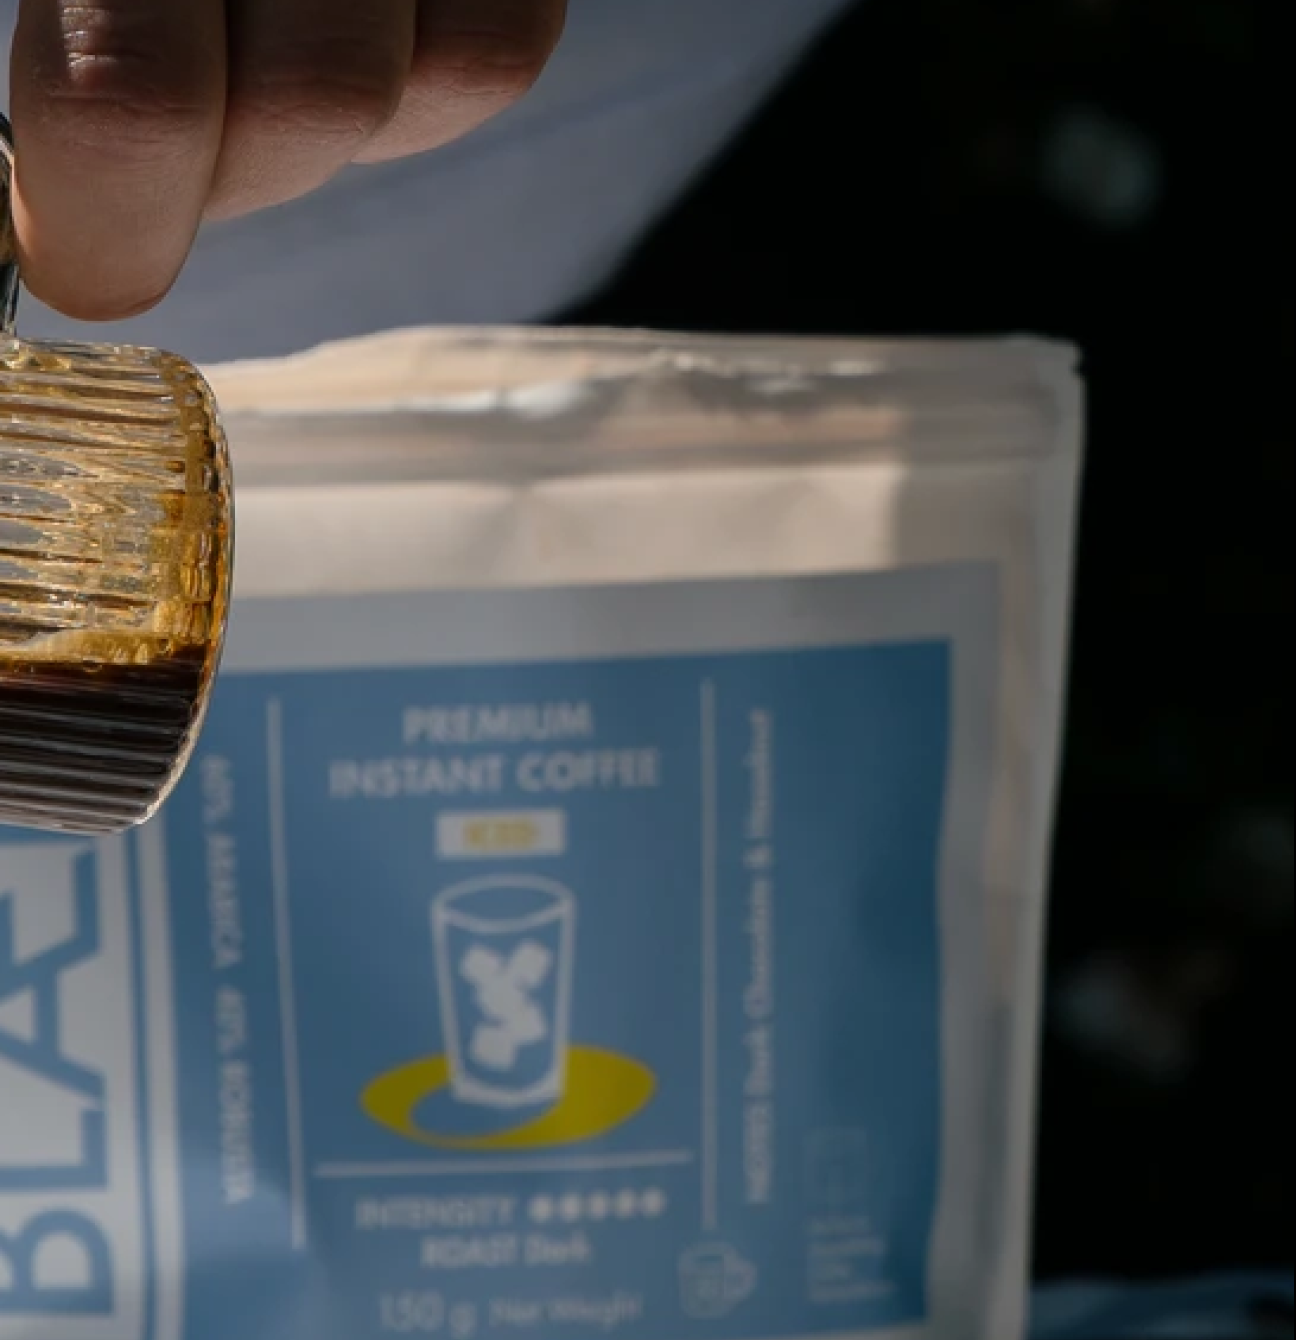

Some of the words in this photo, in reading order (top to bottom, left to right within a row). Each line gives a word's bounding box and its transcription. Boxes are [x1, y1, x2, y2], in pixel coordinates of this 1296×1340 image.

[403, 704, 592, 743] PREMIUM
[329, 754, 505, 797] INSTANT
[517, 748, 658, 791] COFFEE
[357, 1196, 515, 1229] INTENSITY
